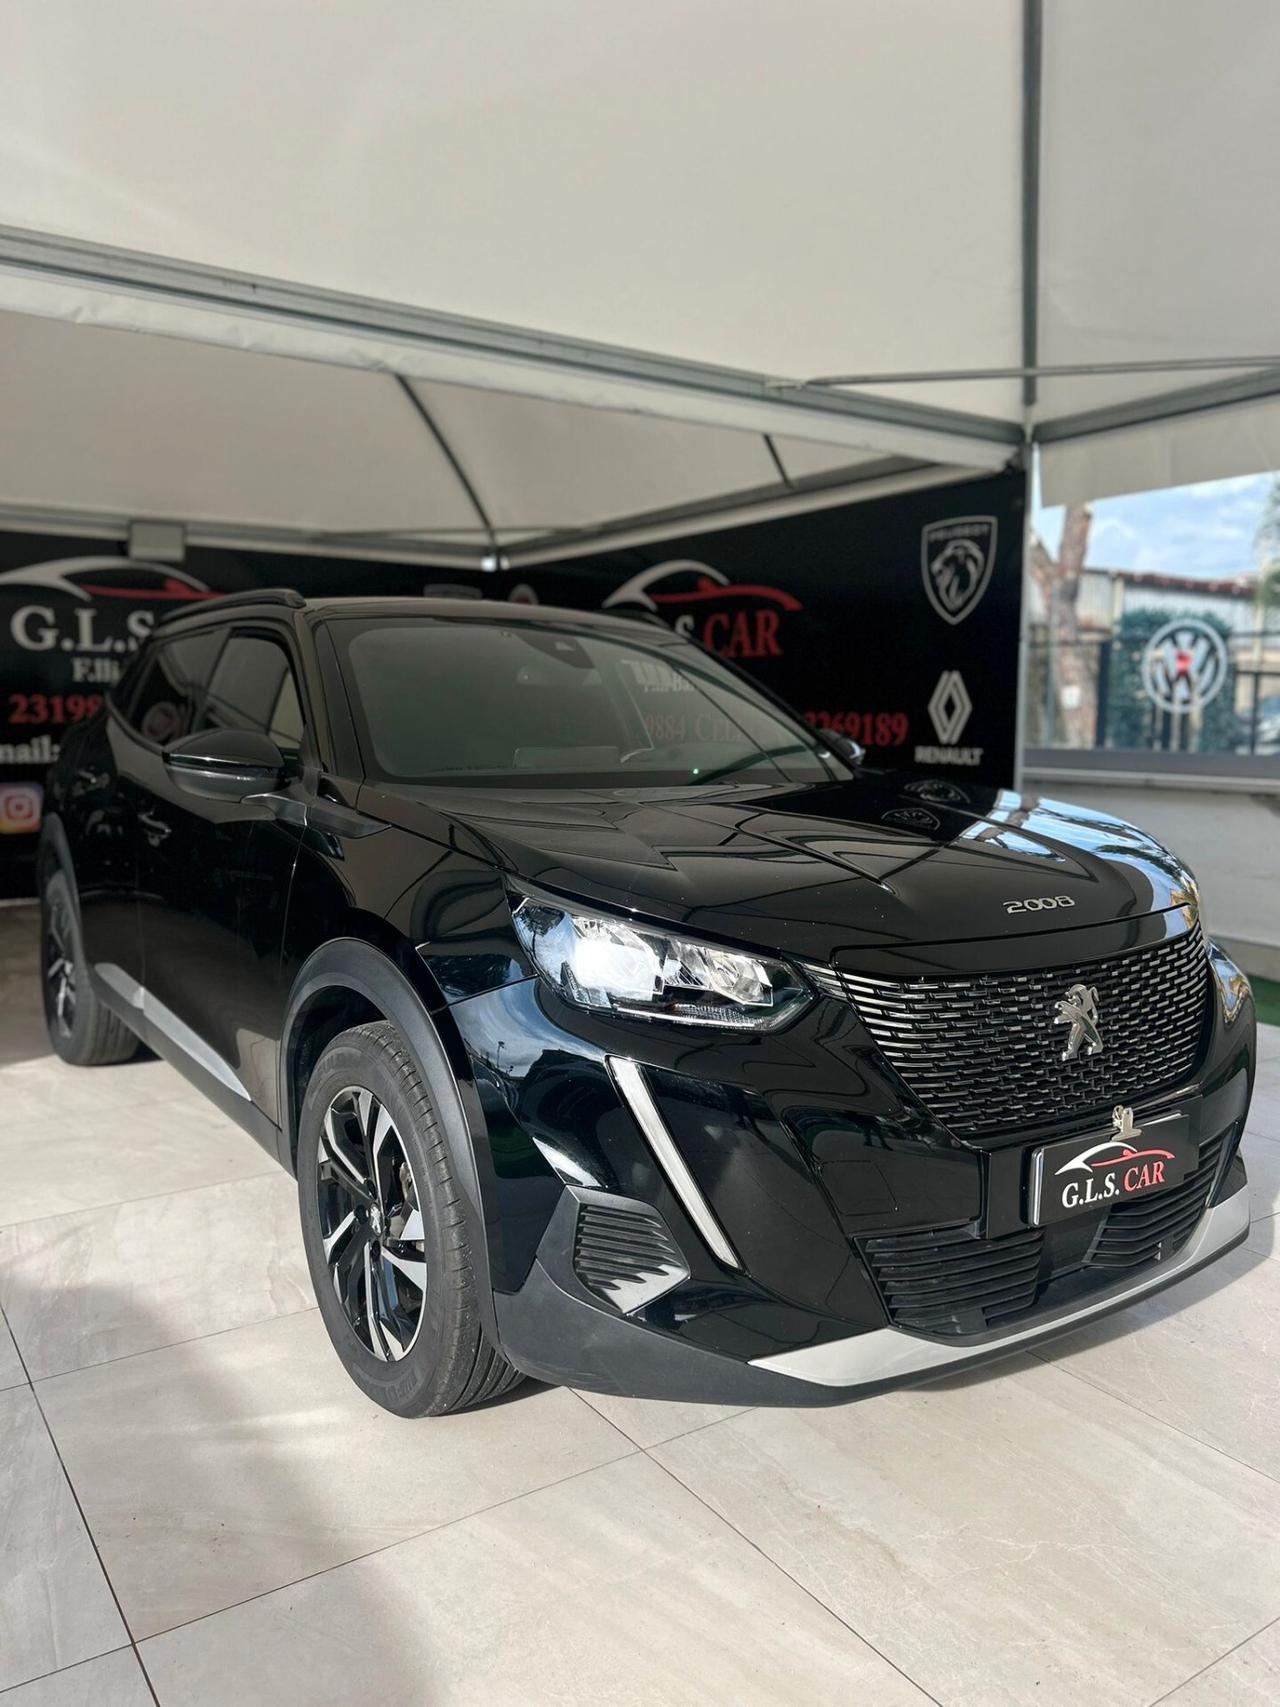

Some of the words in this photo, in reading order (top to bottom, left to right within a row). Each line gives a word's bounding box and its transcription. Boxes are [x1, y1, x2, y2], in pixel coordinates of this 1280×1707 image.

[703, 610, 783, 657] CAR
[1003, 895, 1076, 914] 2008
[1062, 1173, 1120, 1209] G.L.S.
[1124, 1161, 1165, 1192] CAR
